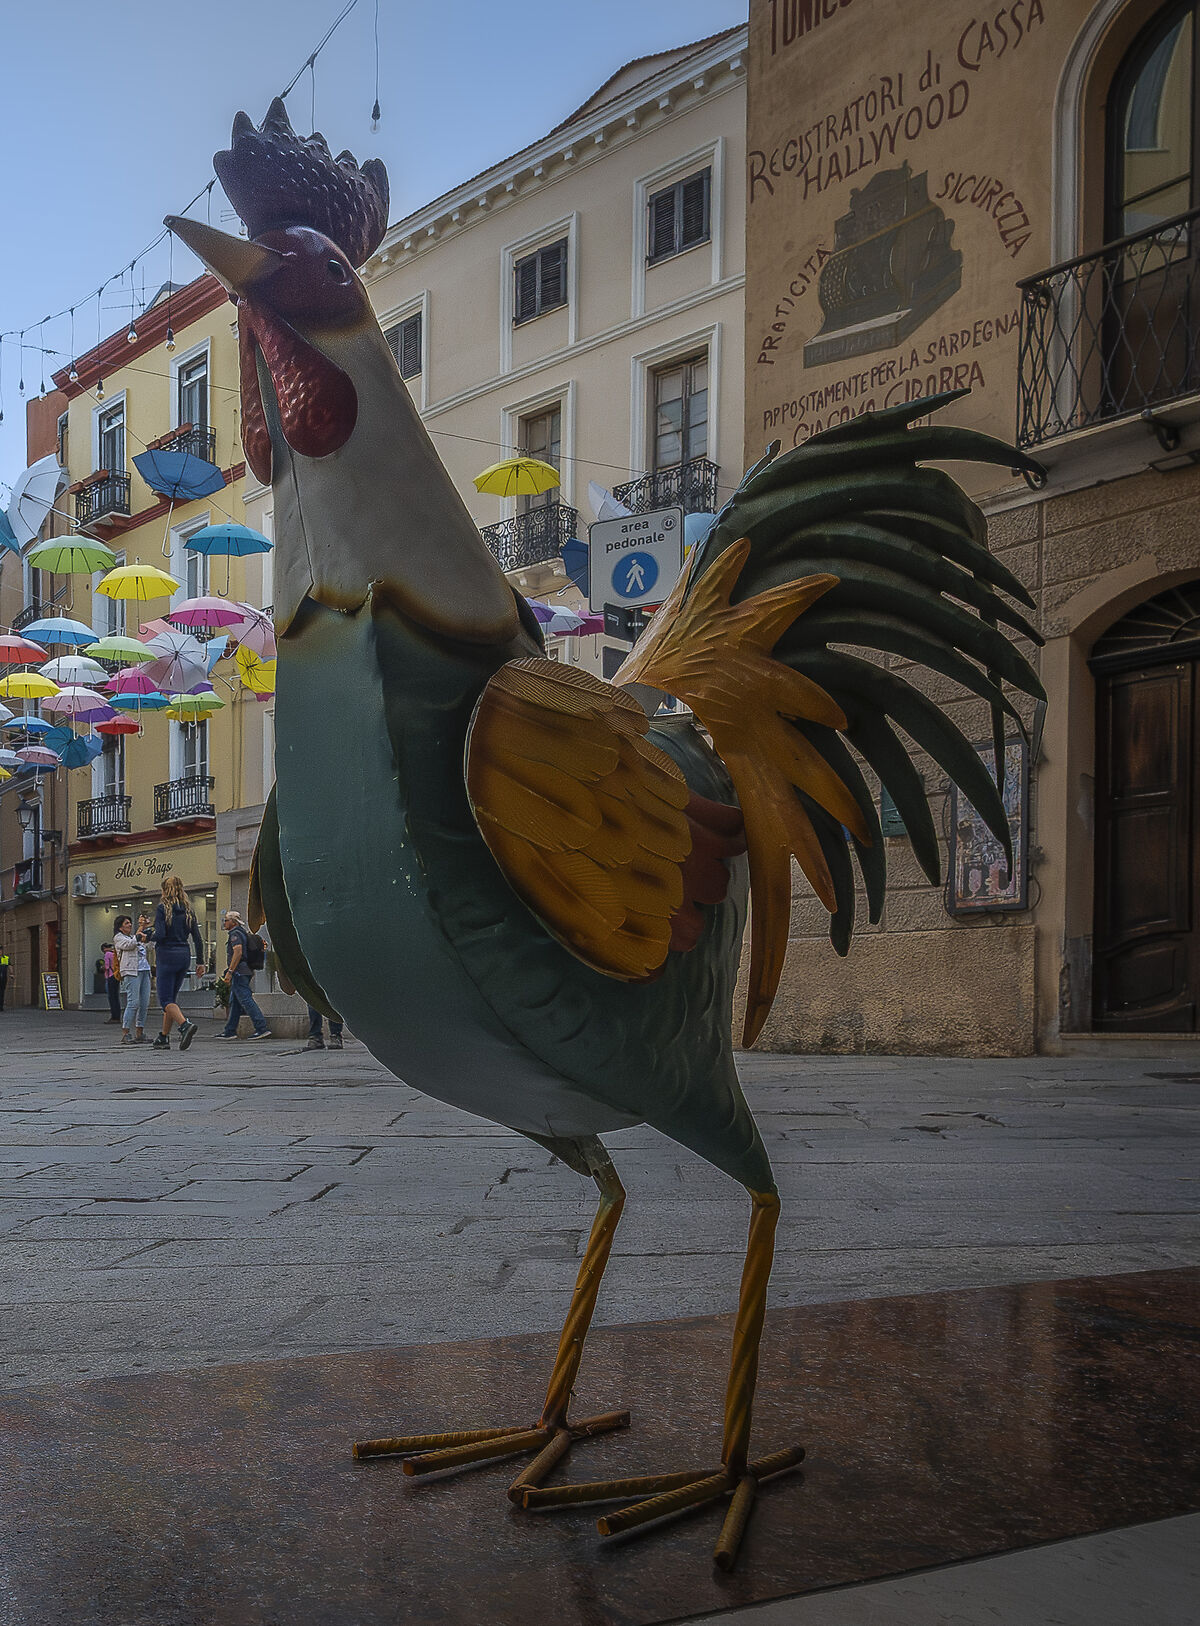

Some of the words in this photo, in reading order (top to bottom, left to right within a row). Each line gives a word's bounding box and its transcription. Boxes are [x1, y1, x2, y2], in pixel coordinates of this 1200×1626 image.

[749, 73, 903, 203] REGISTRATORI
[919, 50, 940, 92] di
[957, 0, 1045, 71] CASSA
[803, 79, 969, 200] HALLWOOD
[936, 172, 1032, 258] SICUREZZA
[899, 349, 920, 377] LA
[923, 309, 1021, 364] SARDEGNA
[605, 531, 665, 554] pedonale
[621, 520, 649, 534] area
